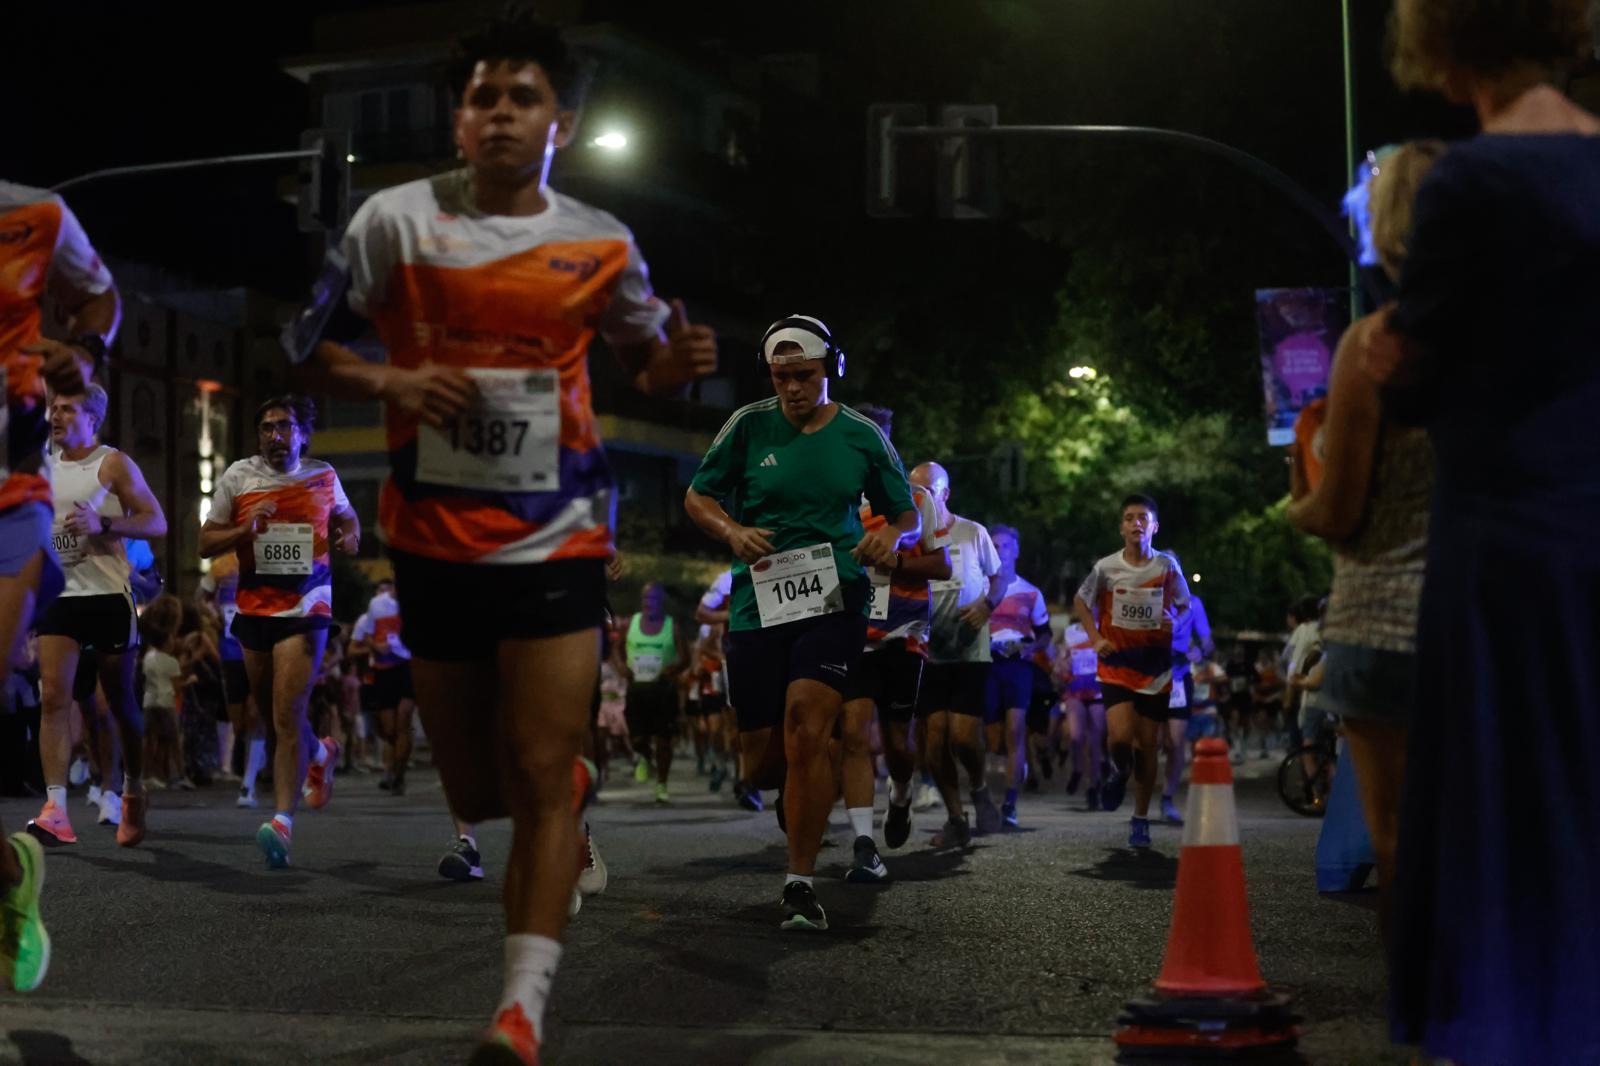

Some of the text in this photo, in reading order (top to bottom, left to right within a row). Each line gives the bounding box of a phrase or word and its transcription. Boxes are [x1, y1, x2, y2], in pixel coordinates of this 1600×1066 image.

[446, 419, 529, 456] 1387
[264, 544, 301, 560] 6886
[772, 573, 823, 604] 1044
[1121, 604, 1153, 618] 5990
